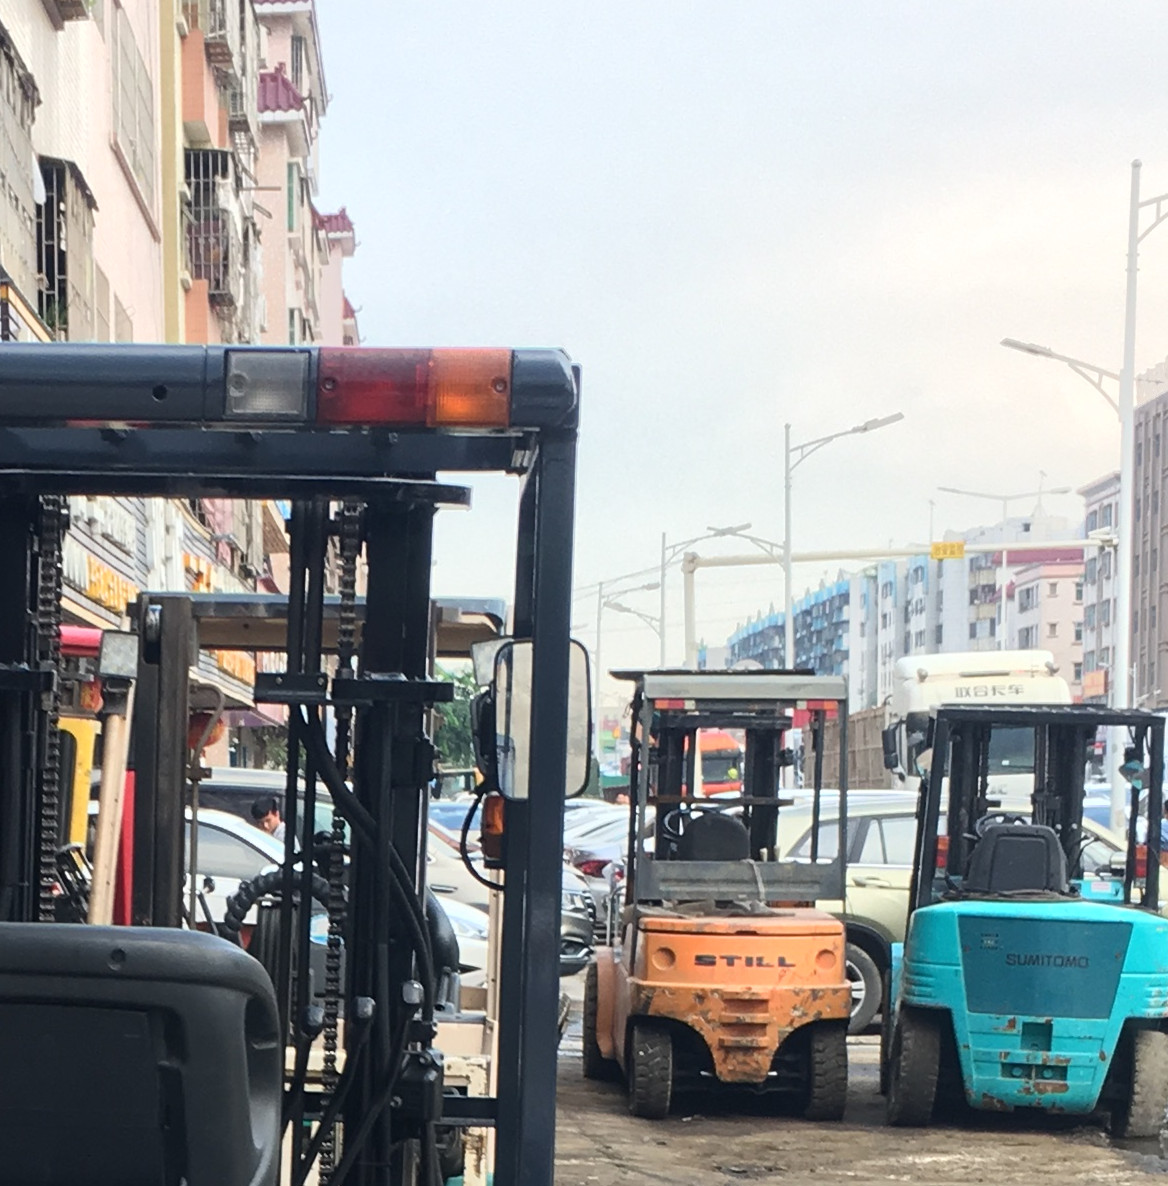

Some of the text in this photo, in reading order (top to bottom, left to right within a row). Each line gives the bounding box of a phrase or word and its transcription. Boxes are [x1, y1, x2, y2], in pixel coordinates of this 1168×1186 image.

[955, 684, 1025, 698] 联合卡车
[694, 954, 796, 968] STILL
[1005, 953, 1090, 969] SUMITOMO
